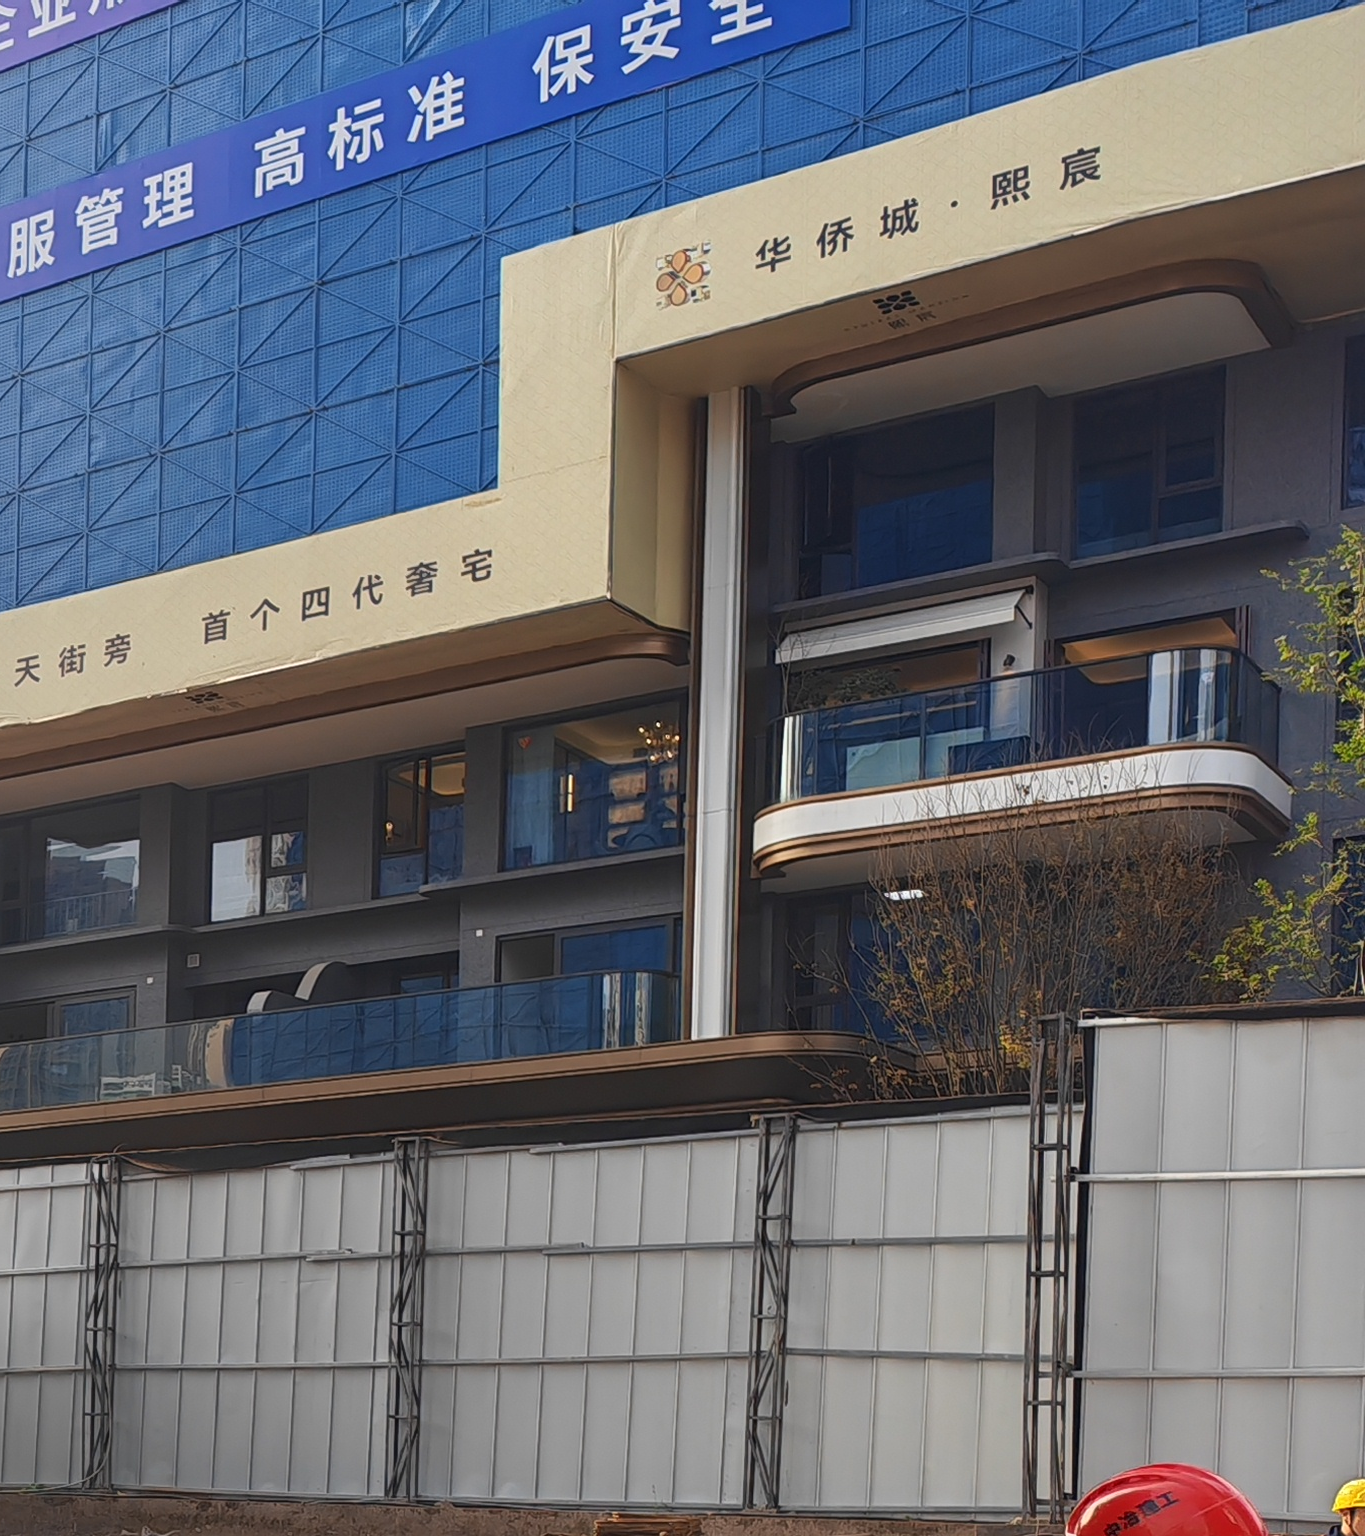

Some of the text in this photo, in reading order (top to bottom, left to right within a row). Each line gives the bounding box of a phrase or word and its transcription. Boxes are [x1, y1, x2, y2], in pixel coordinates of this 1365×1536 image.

[7, 162, 195, 279] 服管理
[254, 71, 466, 199] 高标准
[201, 547, 495, 645] 首个四代奢宅
